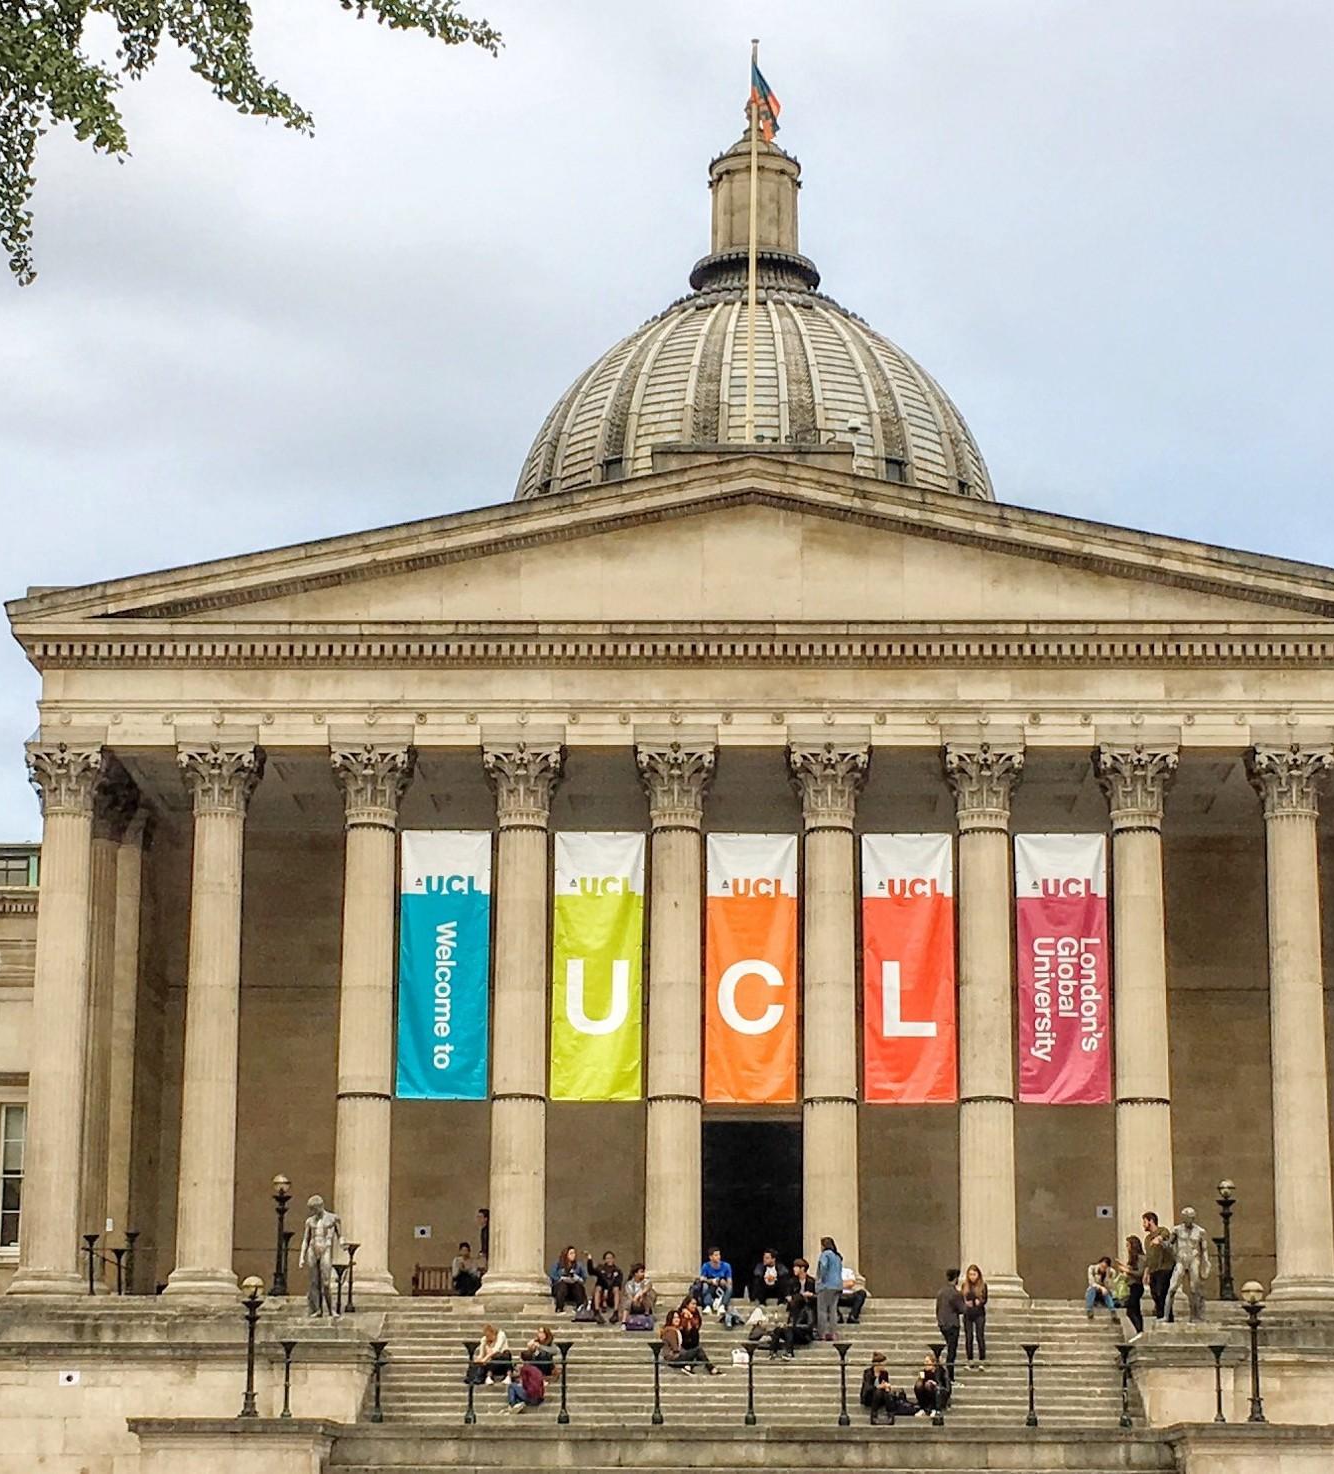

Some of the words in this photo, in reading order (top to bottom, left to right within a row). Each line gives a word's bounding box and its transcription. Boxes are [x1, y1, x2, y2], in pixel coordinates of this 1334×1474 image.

[425, 875, 482, 895] UCL
[580, 876, 636, 897] UCL
[732, 877, 789, 898] UCL
[888, 878, 944, 898] UCL
[1042, 877, 1098, 898] UCL
[433, 921, 457, 1038] Welcome
[566, 960, 629, 1035] U
[717, 959, 785, 1035] C
[881, 961, 938, 1038] L
[1030, 937, 1056, 1062] University
[1056, 937, 1079, 1018] Global
[1080, 938, 1103, 1052] London's
[433, 1043, 455, 1070] to
